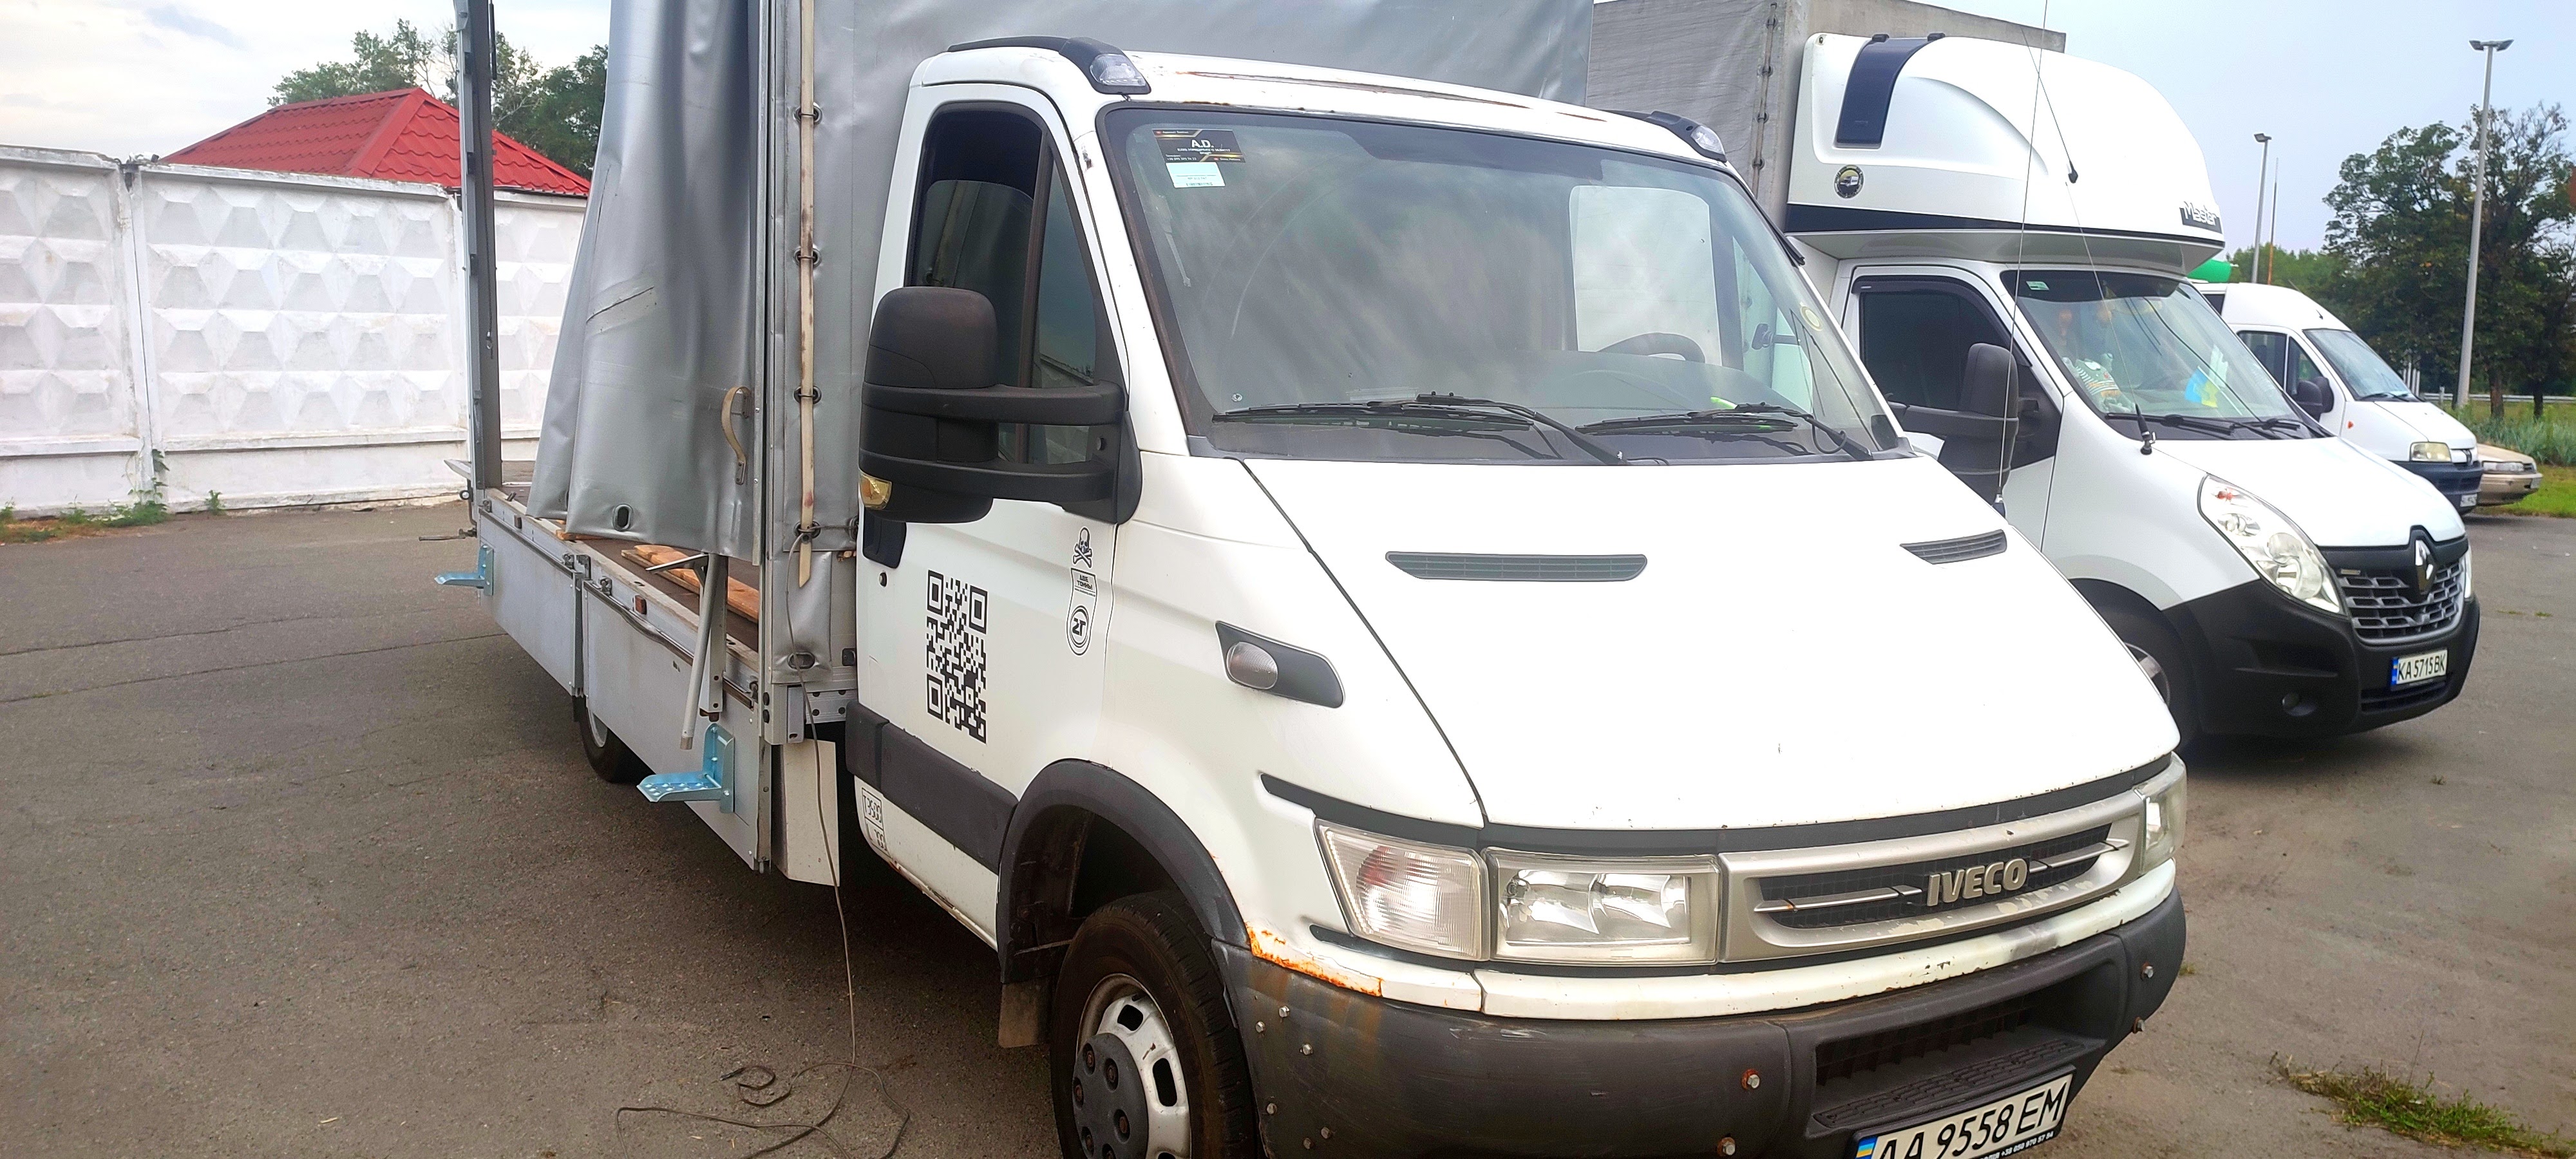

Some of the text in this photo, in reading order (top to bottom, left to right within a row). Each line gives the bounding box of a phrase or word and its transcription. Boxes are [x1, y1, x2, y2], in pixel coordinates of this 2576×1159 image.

[2398, 653, 2446, 681] KA 5715 BK
[1927, 858, 2028, 907] IVECO
[1937, 1104, 2014, 1159] 9558
[2015, 1082, 2067, 1136] EM
